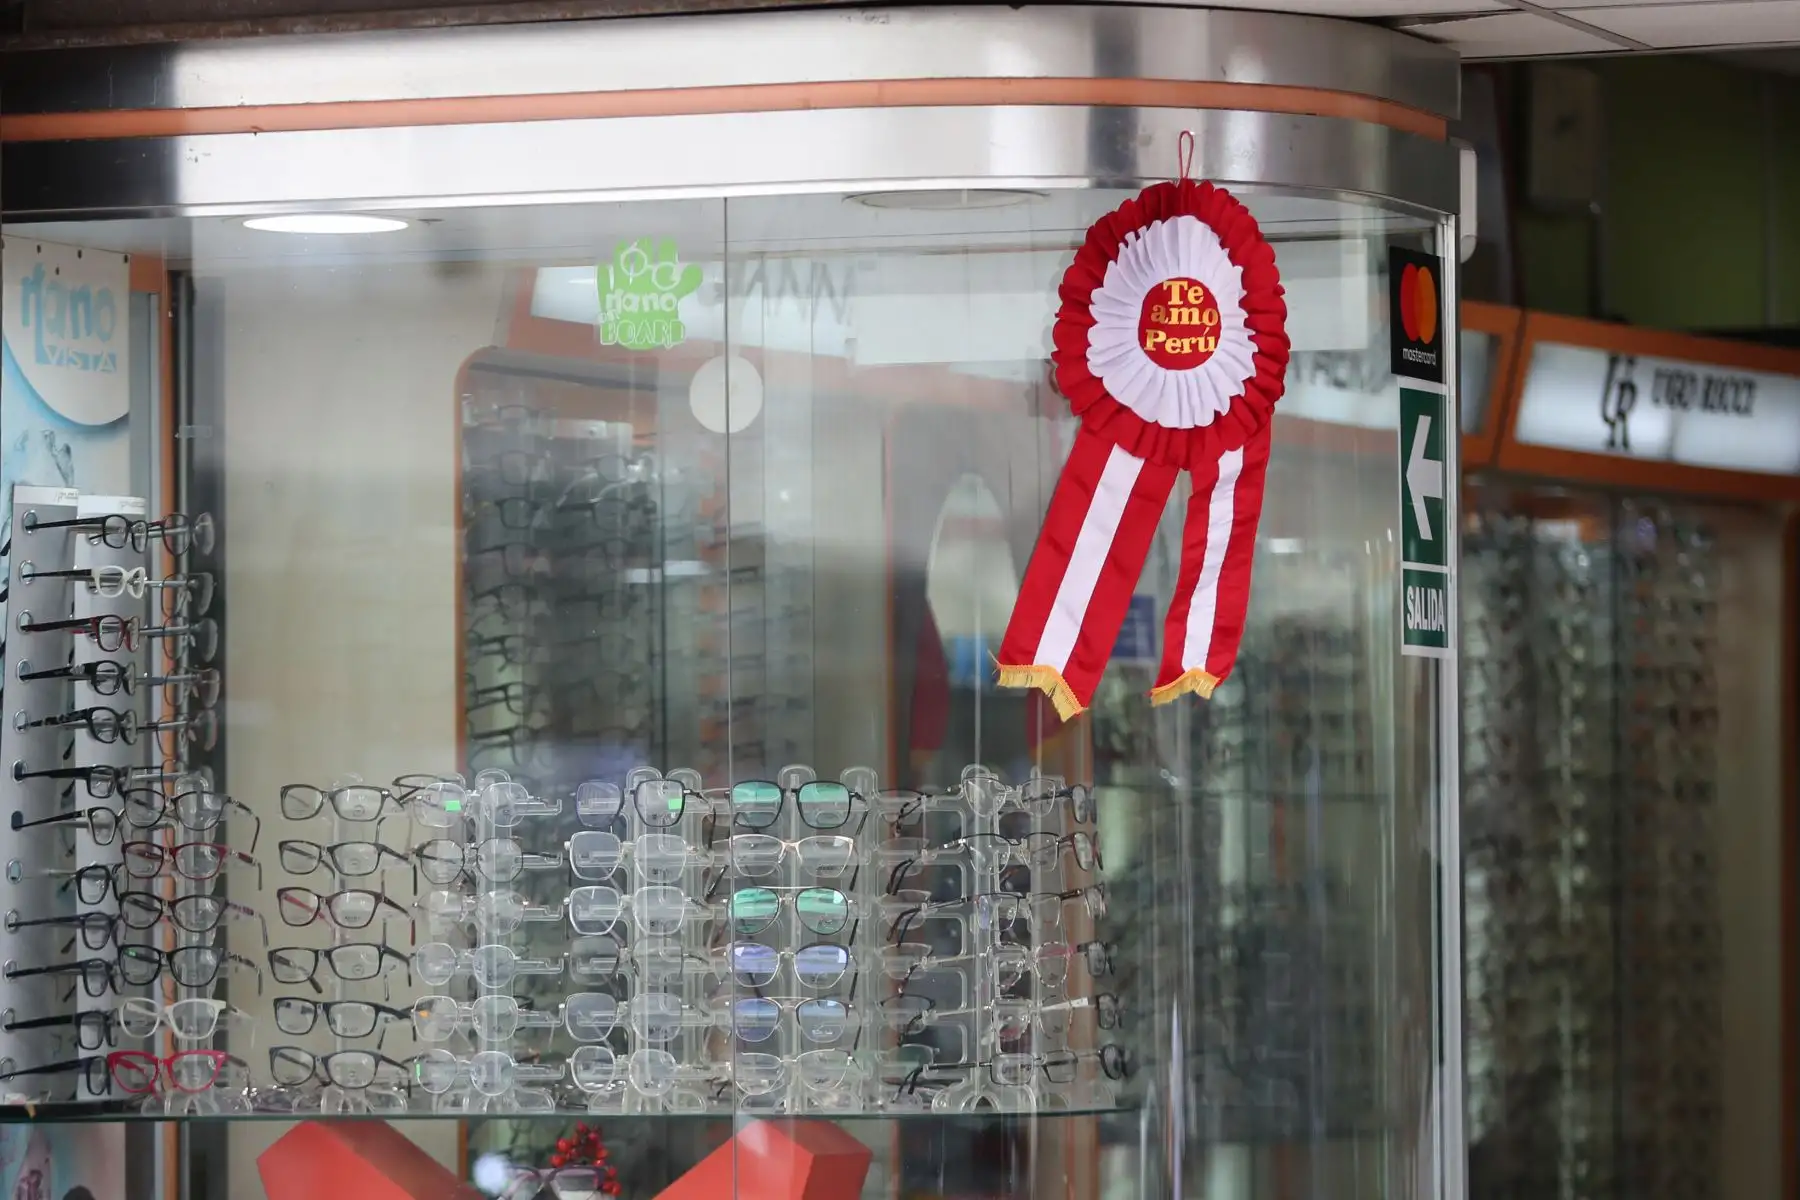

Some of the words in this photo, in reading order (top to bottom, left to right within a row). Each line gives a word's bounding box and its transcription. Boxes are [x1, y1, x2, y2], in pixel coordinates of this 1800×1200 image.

[1163, 280, 1204, 305] Te
[1150, 304, 1219, 326] amo
[600, 319, 686, 349] BOARD
[1144, 327, 1216, 354] Perú
[47, 345, 117, 373] VISTA
[1402, 347, 1436, 366] mastercard
[1406, 585, 1445, 632] SALIDA
